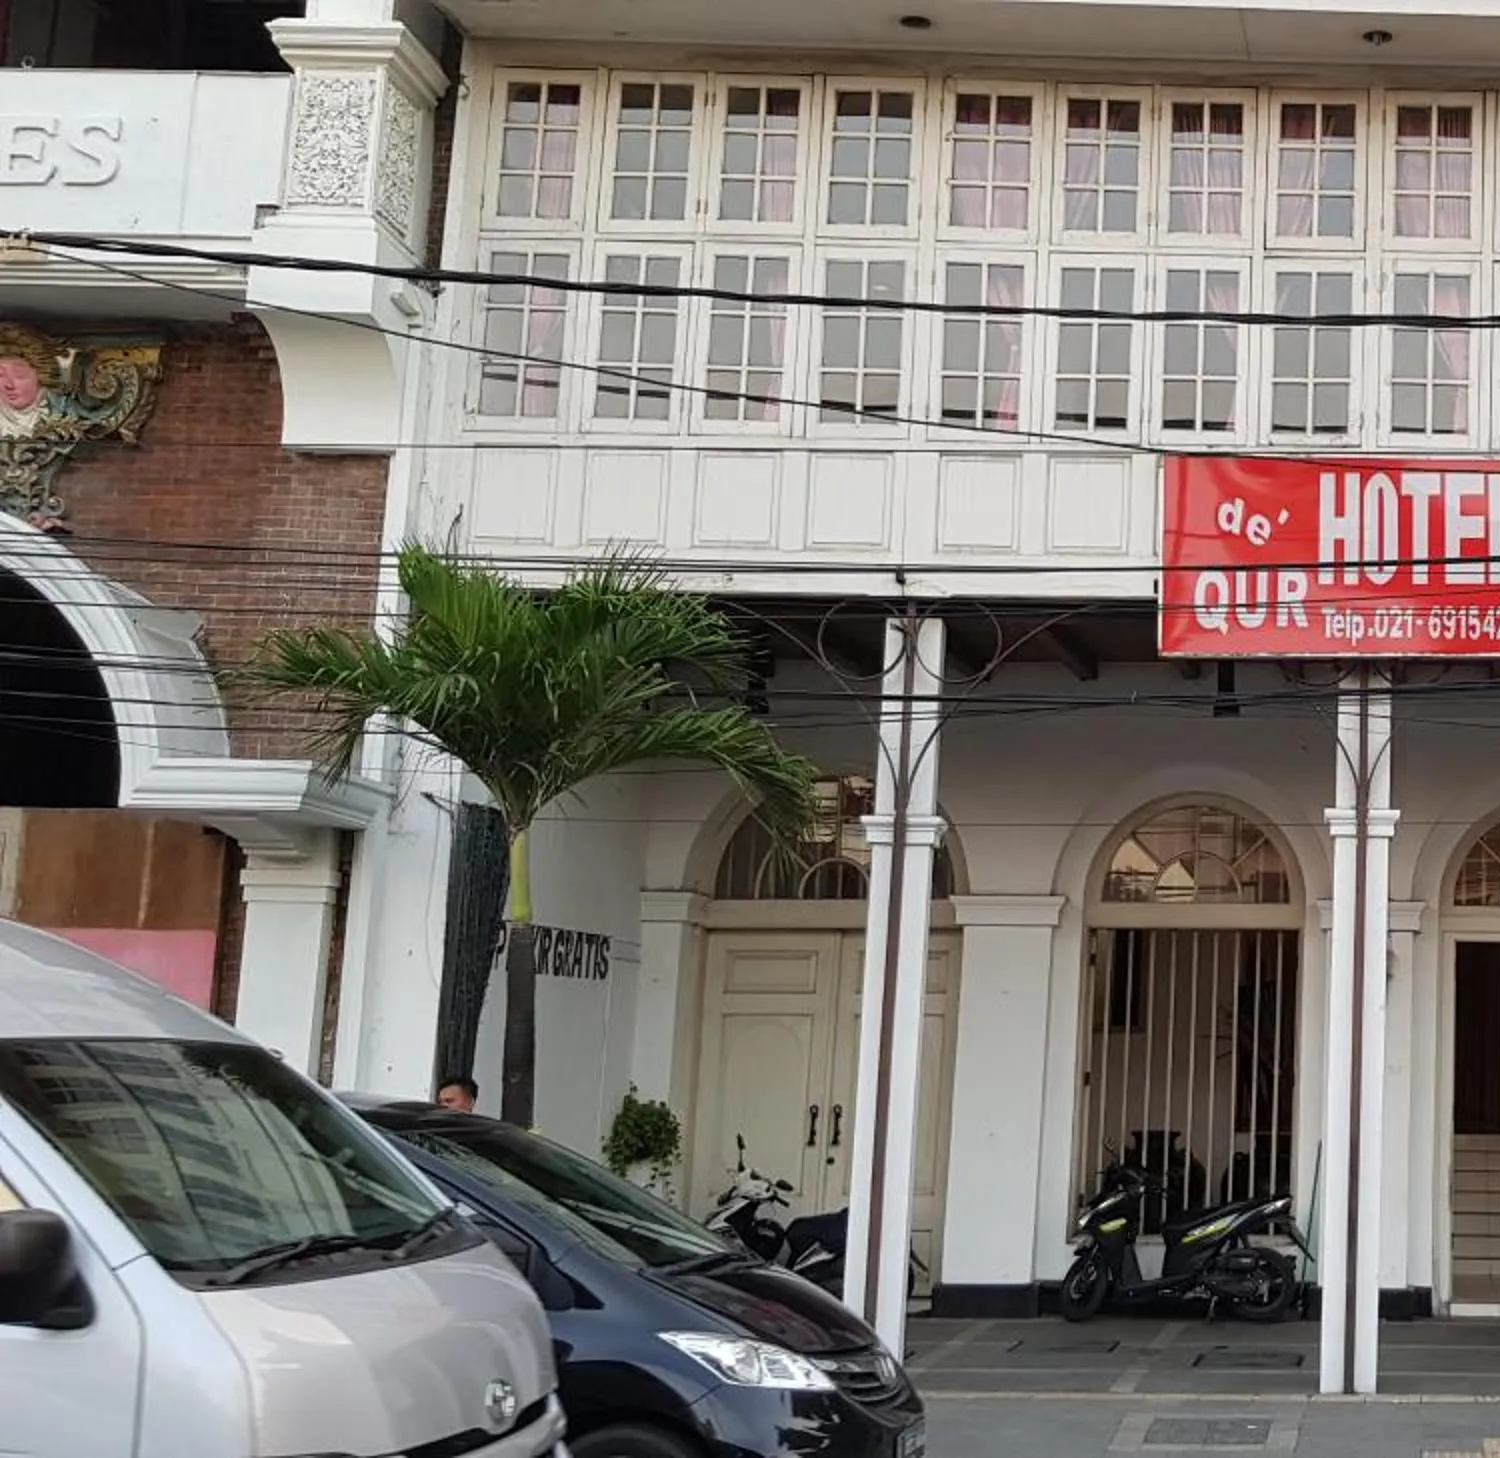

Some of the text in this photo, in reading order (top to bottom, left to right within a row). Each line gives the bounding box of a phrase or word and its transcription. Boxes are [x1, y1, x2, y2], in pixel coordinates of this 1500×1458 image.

[1216, 498, 1290, 547] de'
[1193, 569, 1310, 636] QUR
[553, 927, 611, 980] GRATIS
